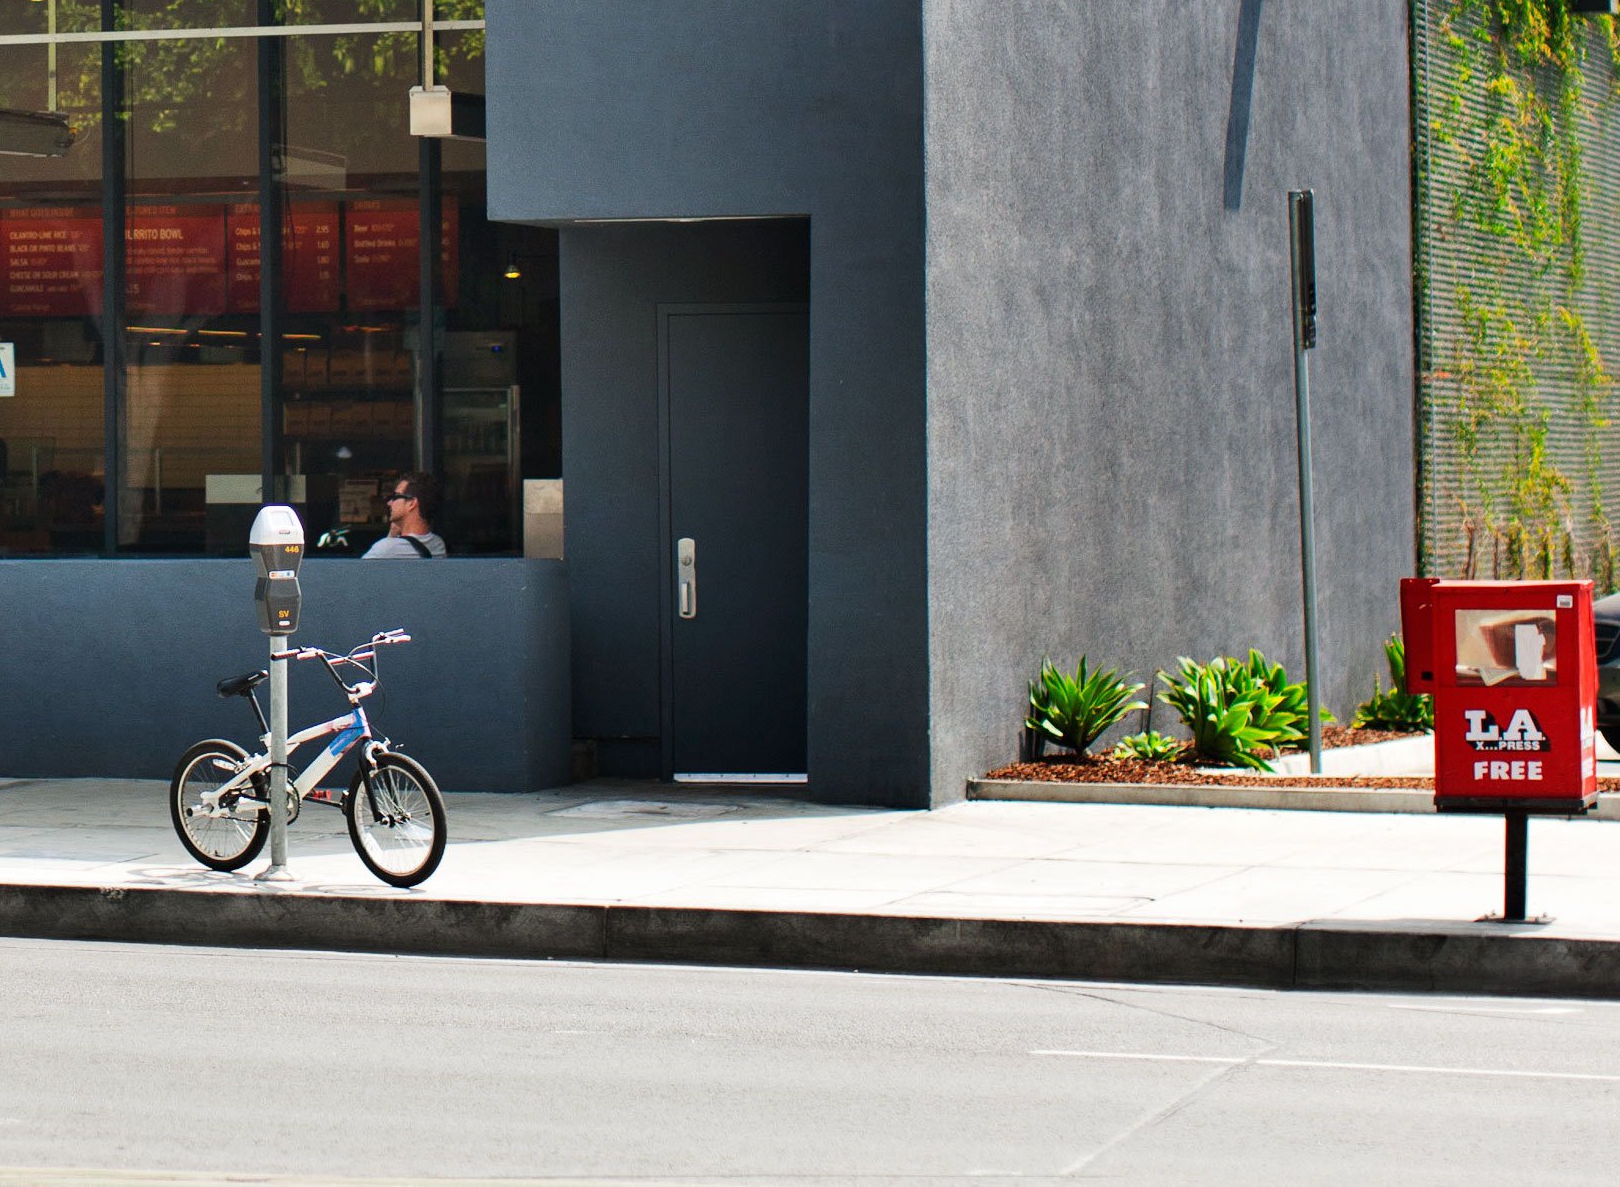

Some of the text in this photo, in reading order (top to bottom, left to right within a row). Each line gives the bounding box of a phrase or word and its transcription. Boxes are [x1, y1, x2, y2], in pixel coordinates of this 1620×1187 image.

[125, 228, 184, 240] URRITO BOWL
[285, 545, 299, 553] 446
[278, 609, 289, 618] SV
[1465, 709, 1546, 741] L.A.
[1474, 761, 1543, 780] FREE
